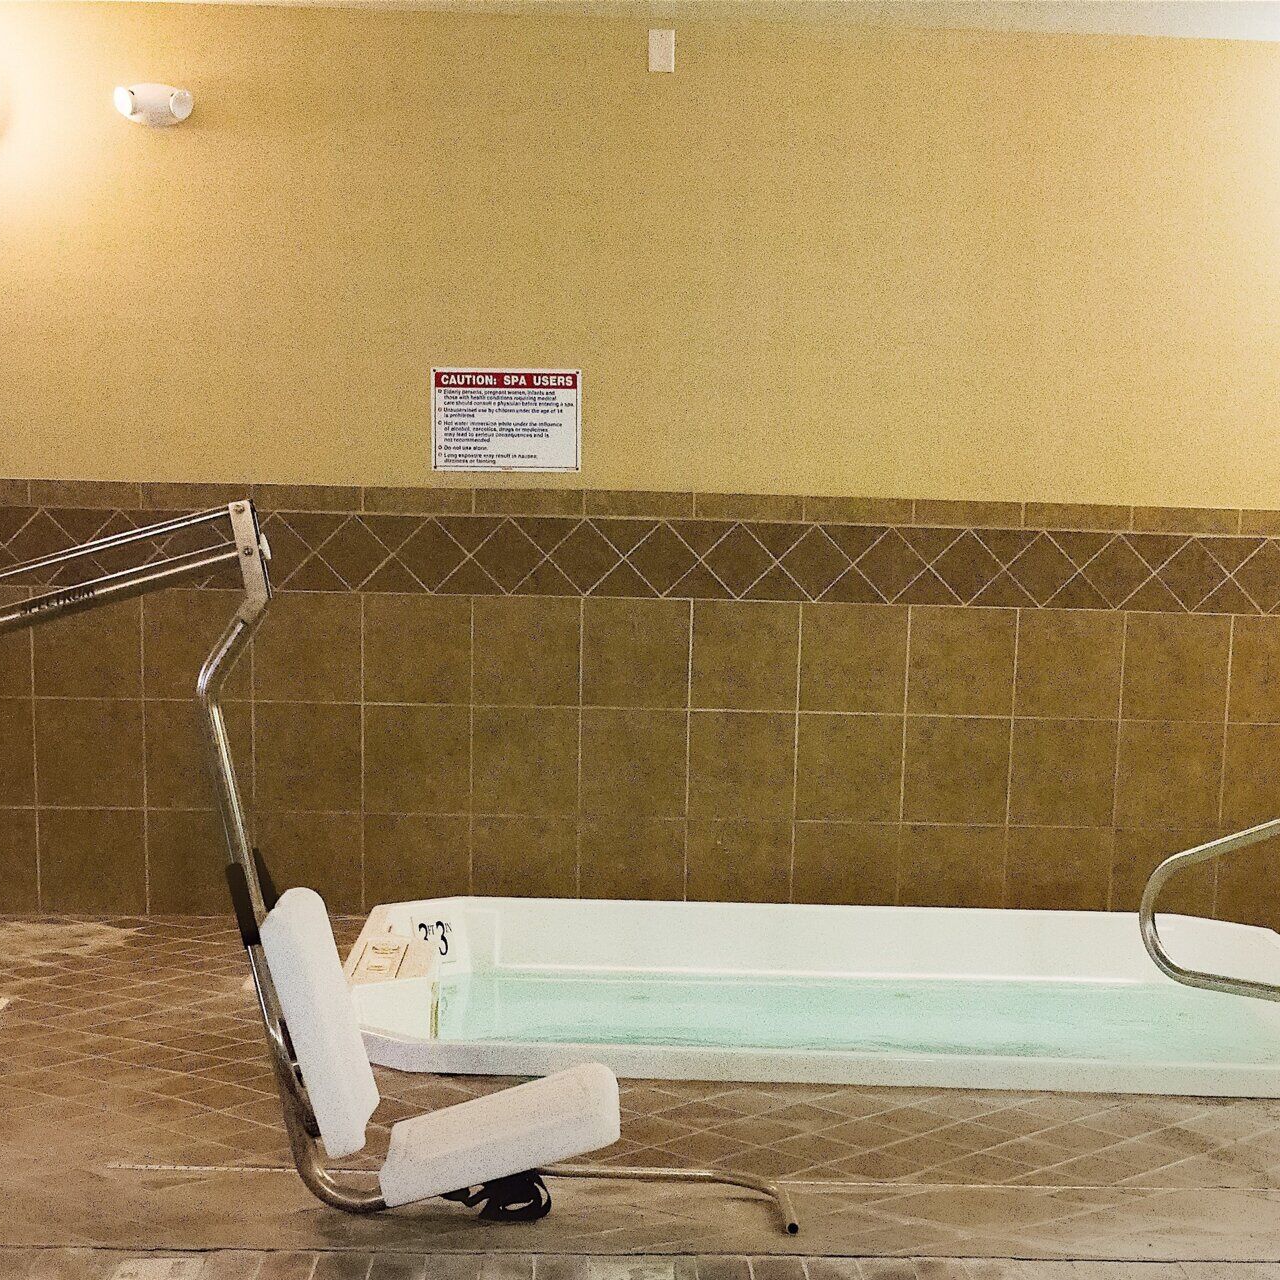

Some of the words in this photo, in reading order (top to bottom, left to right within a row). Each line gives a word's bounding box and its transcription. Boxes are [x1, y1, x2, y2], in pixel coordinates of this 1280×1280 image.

[440, 374, 497, 386] CAUTION:
[503, 374, 527, 386] SPA
[532, 375, 573, 386] USERS
[436, 920, 448, 956] 3
